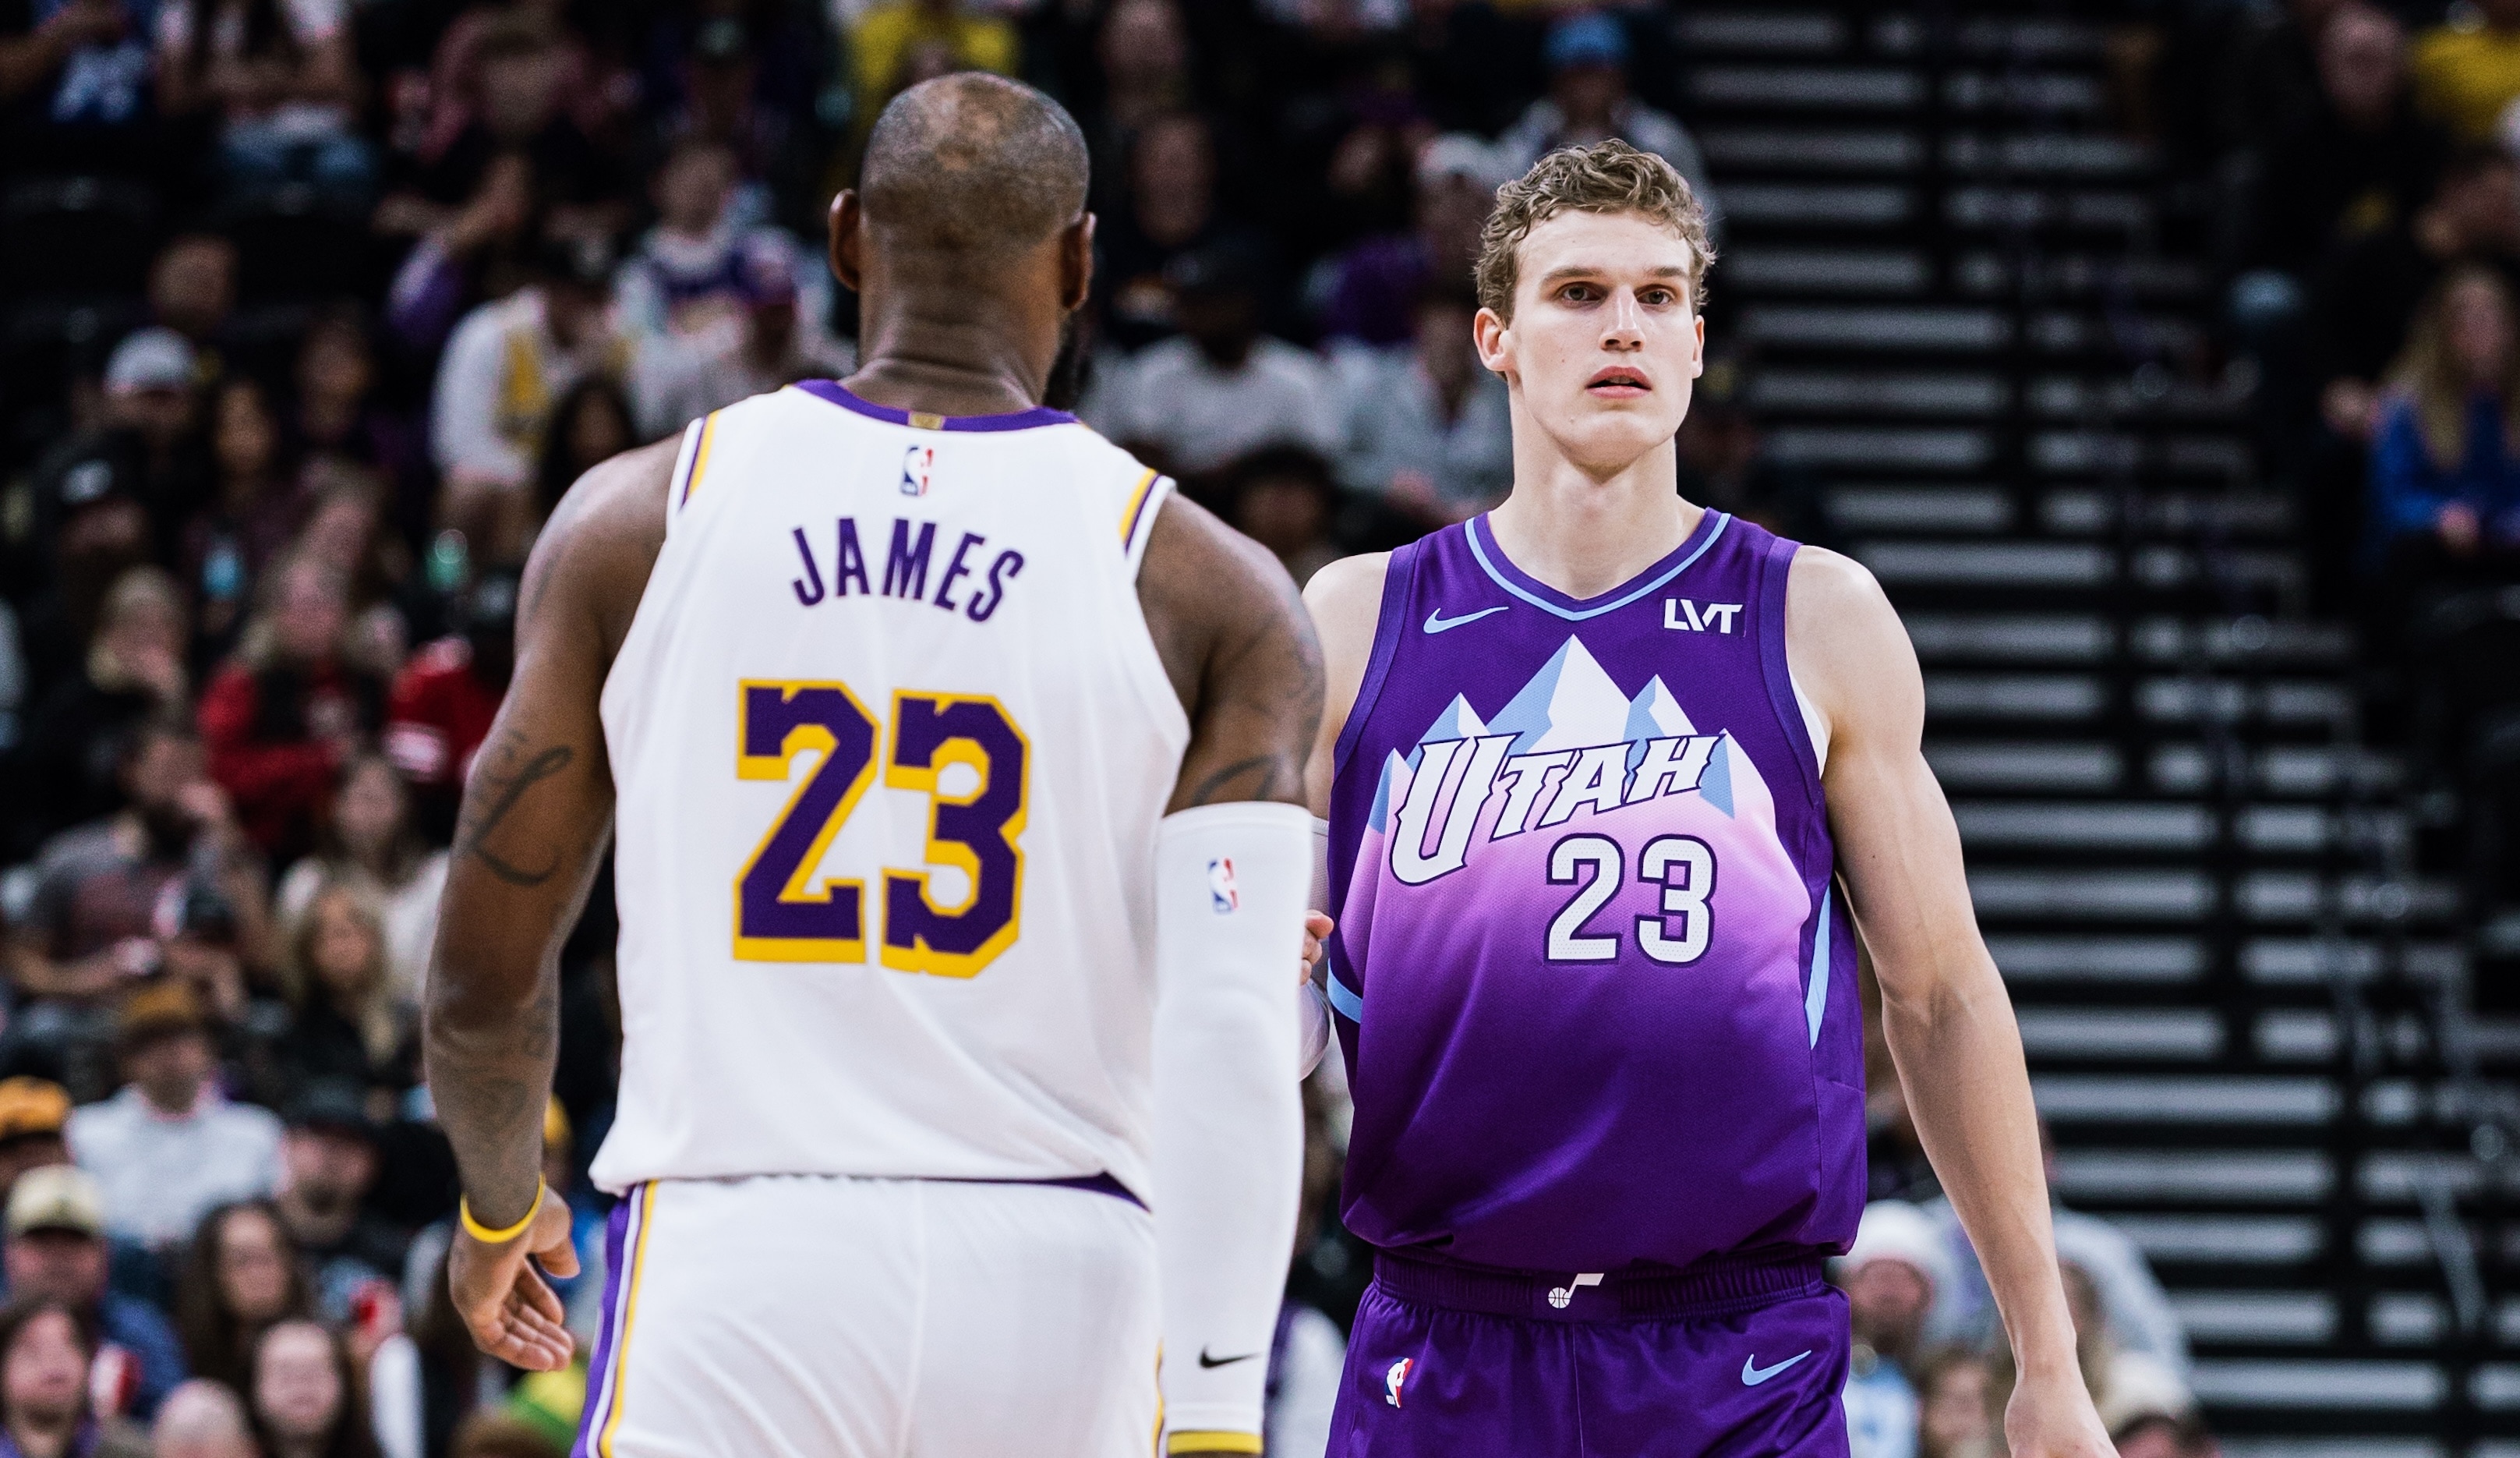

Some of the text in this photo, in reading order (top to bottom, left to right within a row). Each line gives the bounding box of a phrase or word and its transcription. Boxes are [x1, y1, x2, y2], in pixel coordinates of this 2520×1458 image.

[792, 518, 1024, 623] JAMES
[1663, 598, 1744, 634] LVT
[732, 677, 1032, 980] 23
[1389, 731, 1725, 886] UTAH
[1543, 833, 1717, 968] 23
